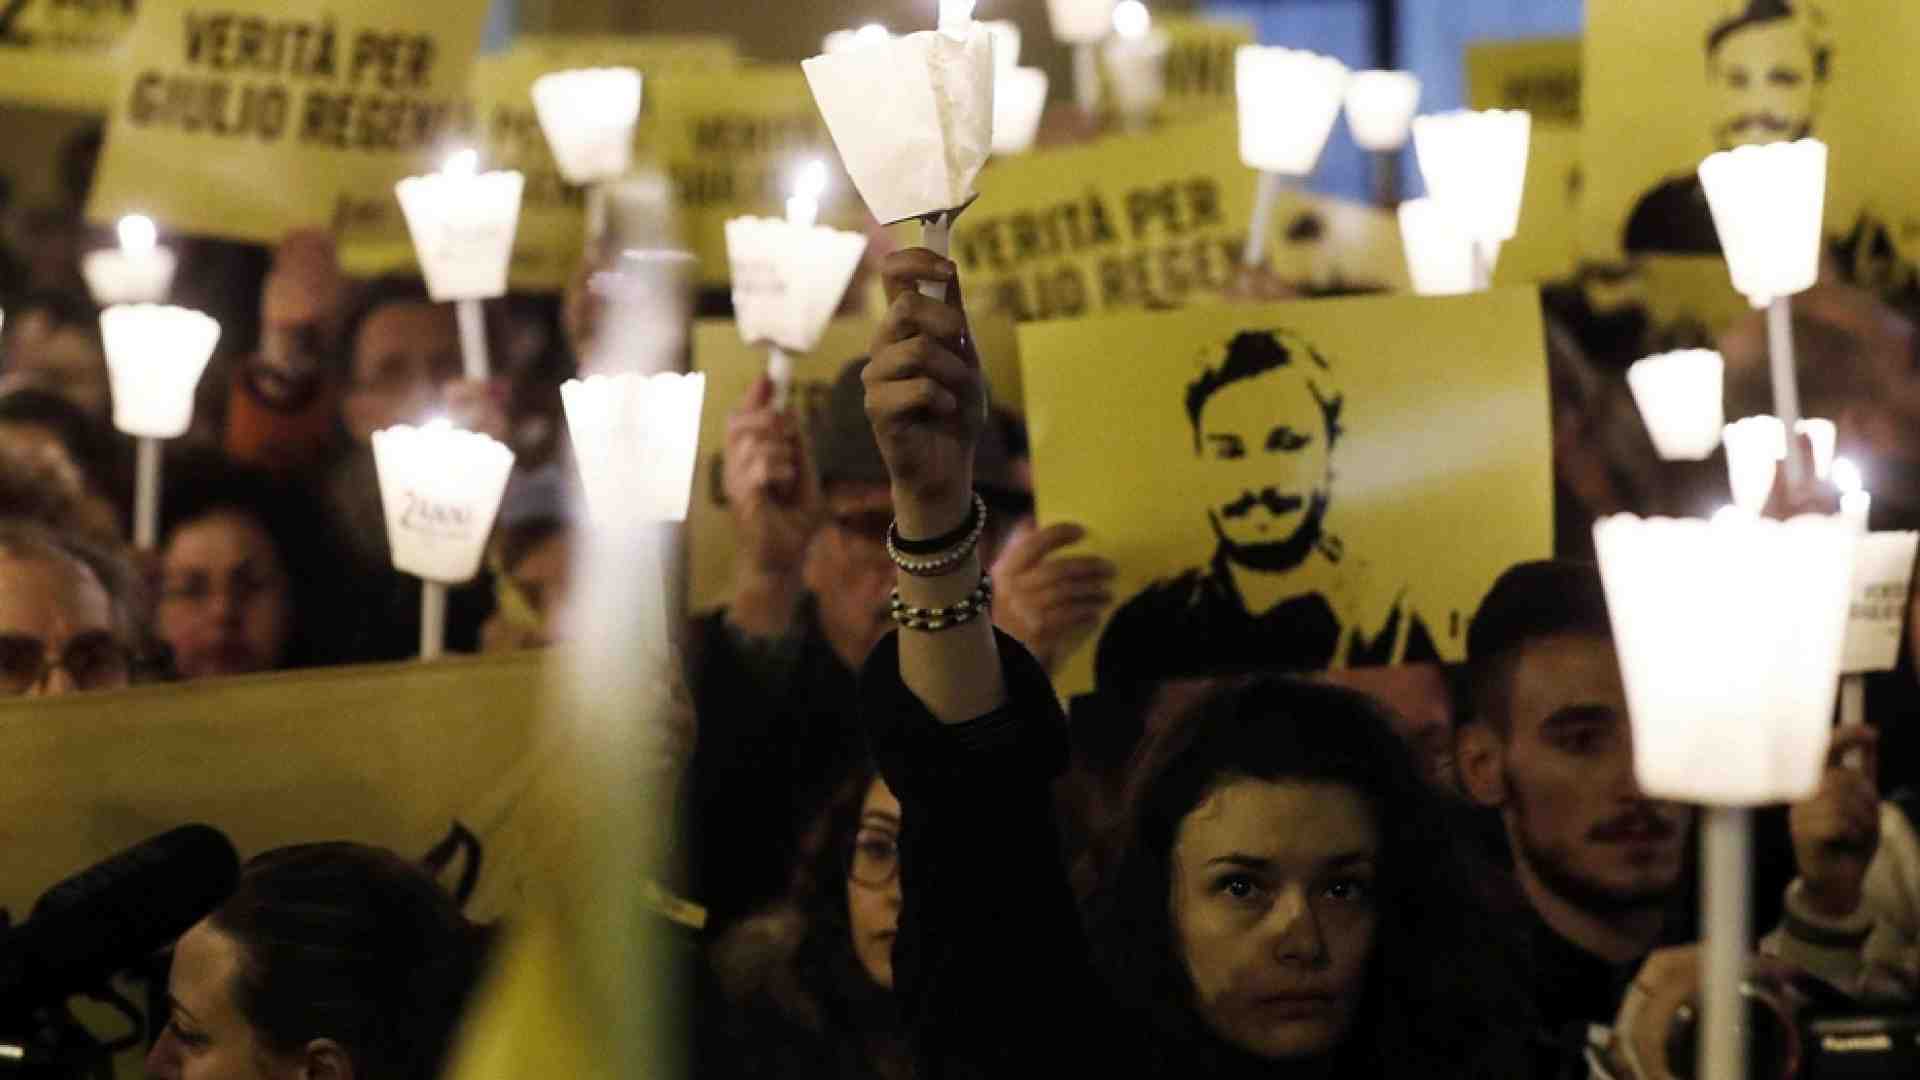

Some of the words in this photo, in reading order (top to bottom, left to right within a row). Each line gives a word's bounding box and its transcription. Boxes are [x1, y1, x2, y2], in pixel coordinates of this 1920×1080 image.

[184, 9, 338, 76] VERITÀ
[353, 29, 437, 88] PER
[130, 70, 290, 142] GIULIO
[1124, 175, 1223, 242] PER
